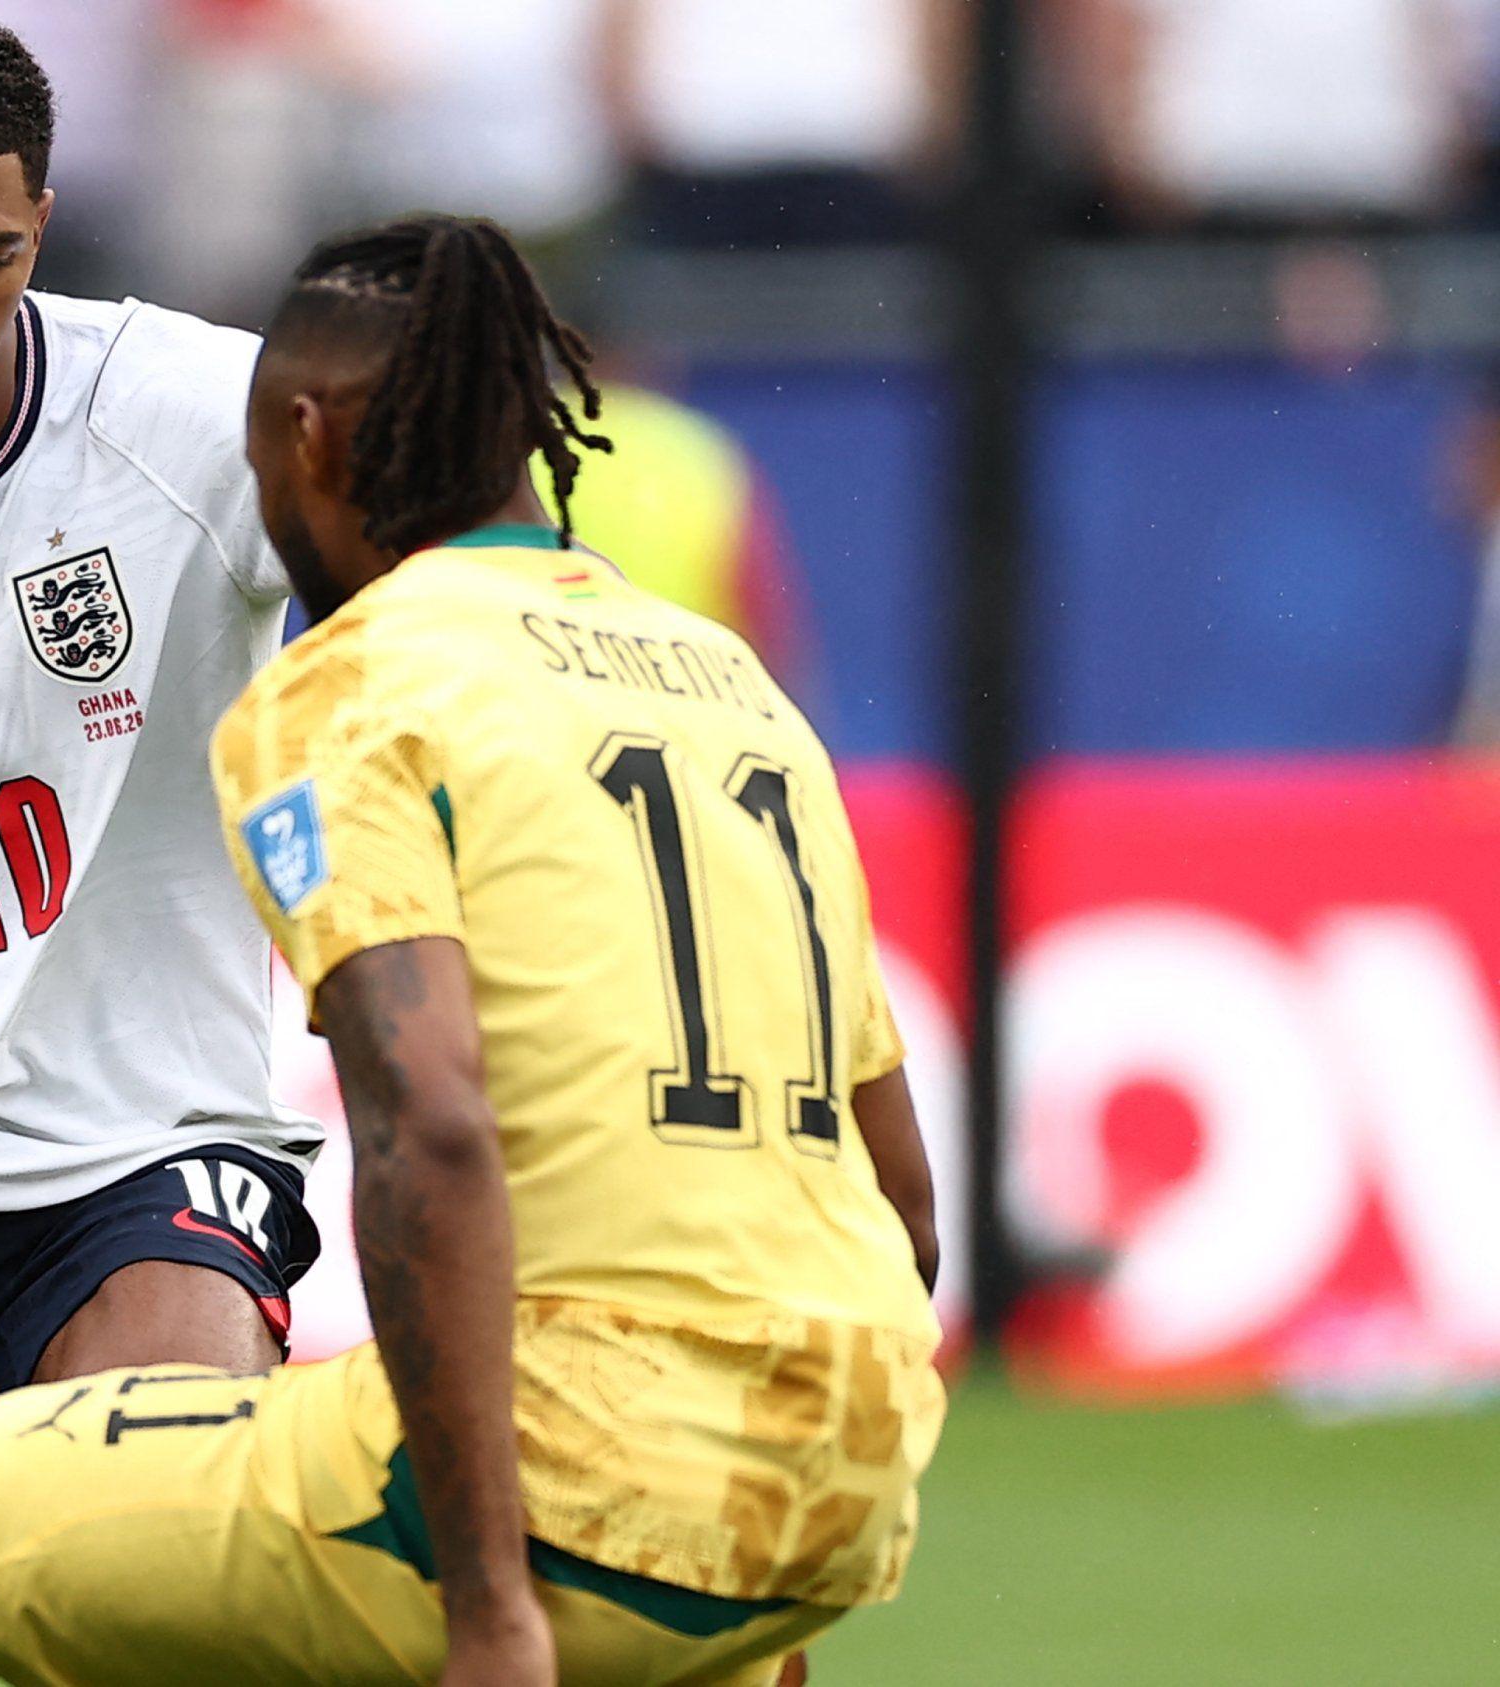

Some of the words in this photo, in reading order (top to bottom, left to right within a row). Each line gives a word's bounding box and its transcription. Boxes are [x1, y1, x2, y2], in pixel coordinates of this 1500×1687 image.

[77, 687, 138, 717] GHANA
[83, 710, 145, 742] 23.06.26
[587, 730, 840, 1162] 11
